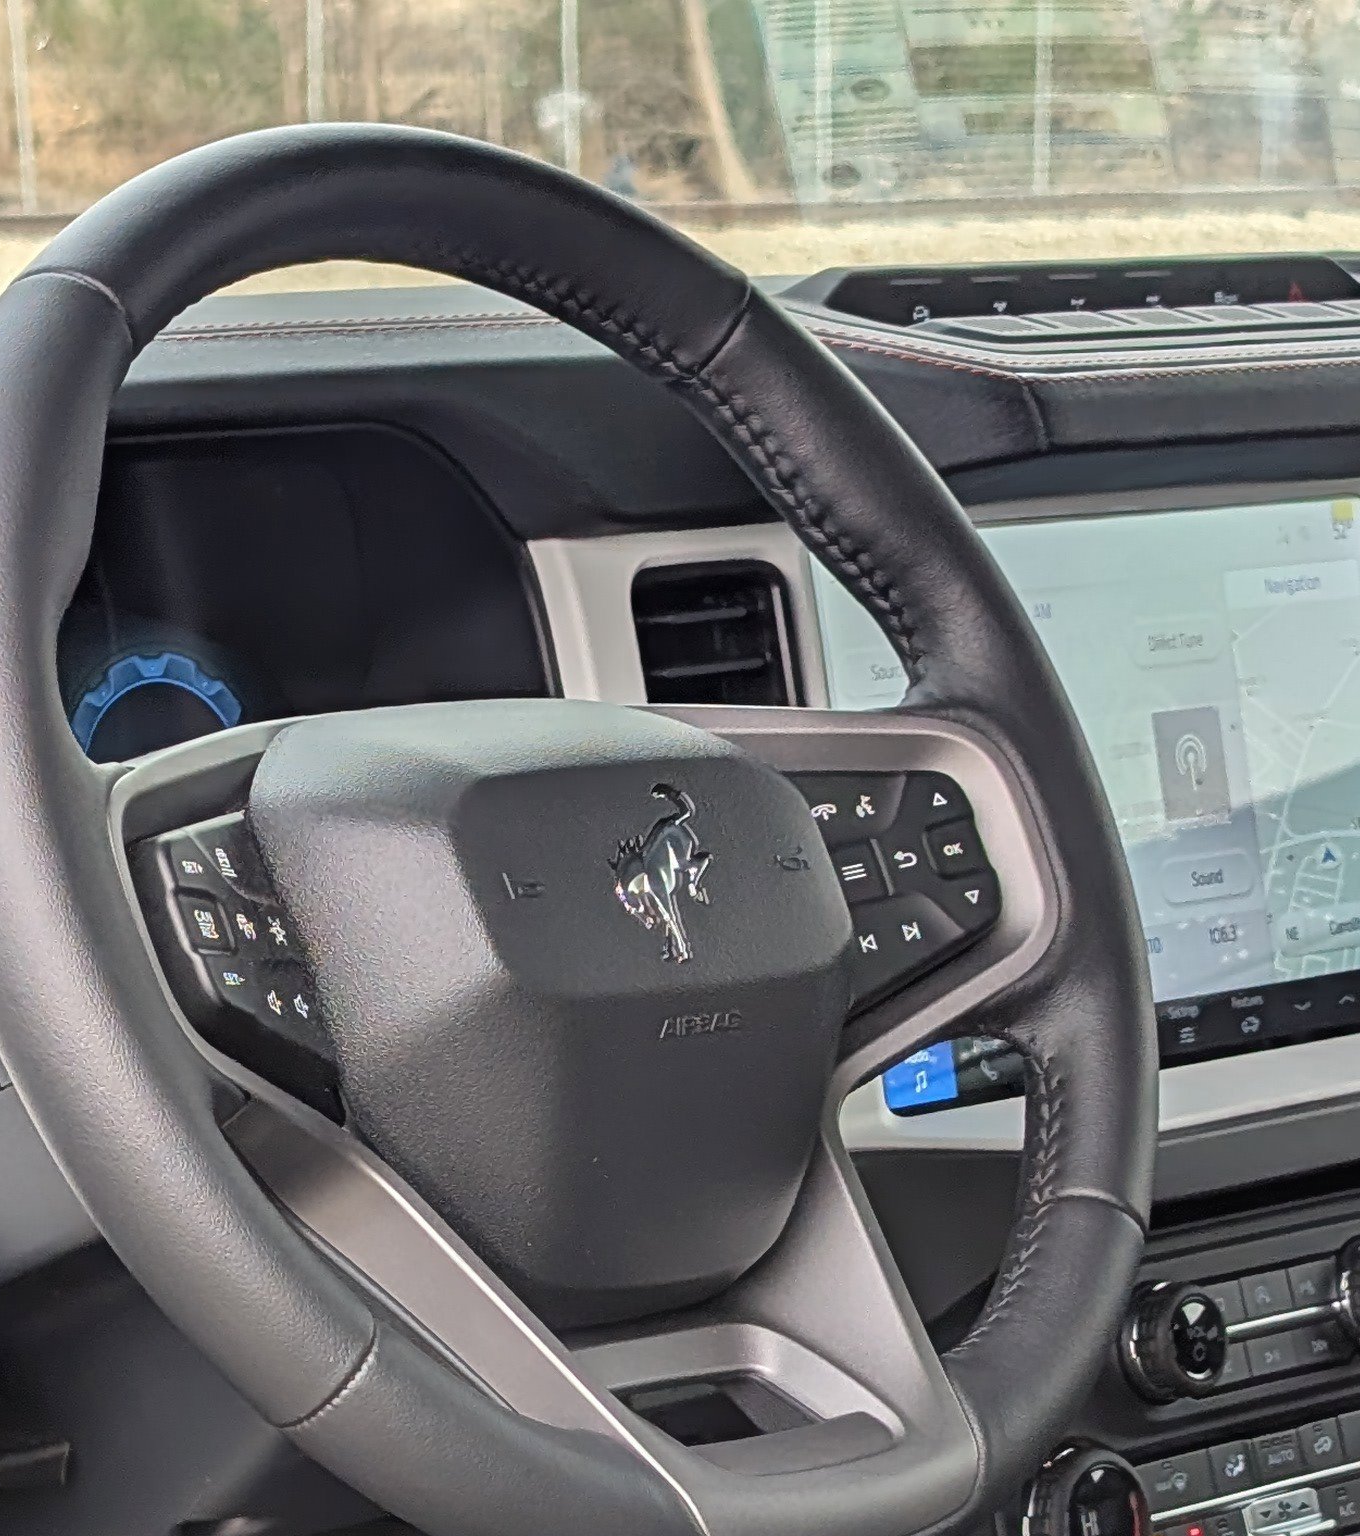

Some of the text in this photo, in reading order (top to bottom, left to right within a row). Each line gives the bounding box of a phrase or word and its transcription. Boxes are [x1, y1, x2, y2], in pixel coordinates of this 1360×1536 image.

[942, 842, 965, 857] OK
[1191, 868, 1224, 888] Sound
[1267, 1448, 1295, 1467] AUTO
